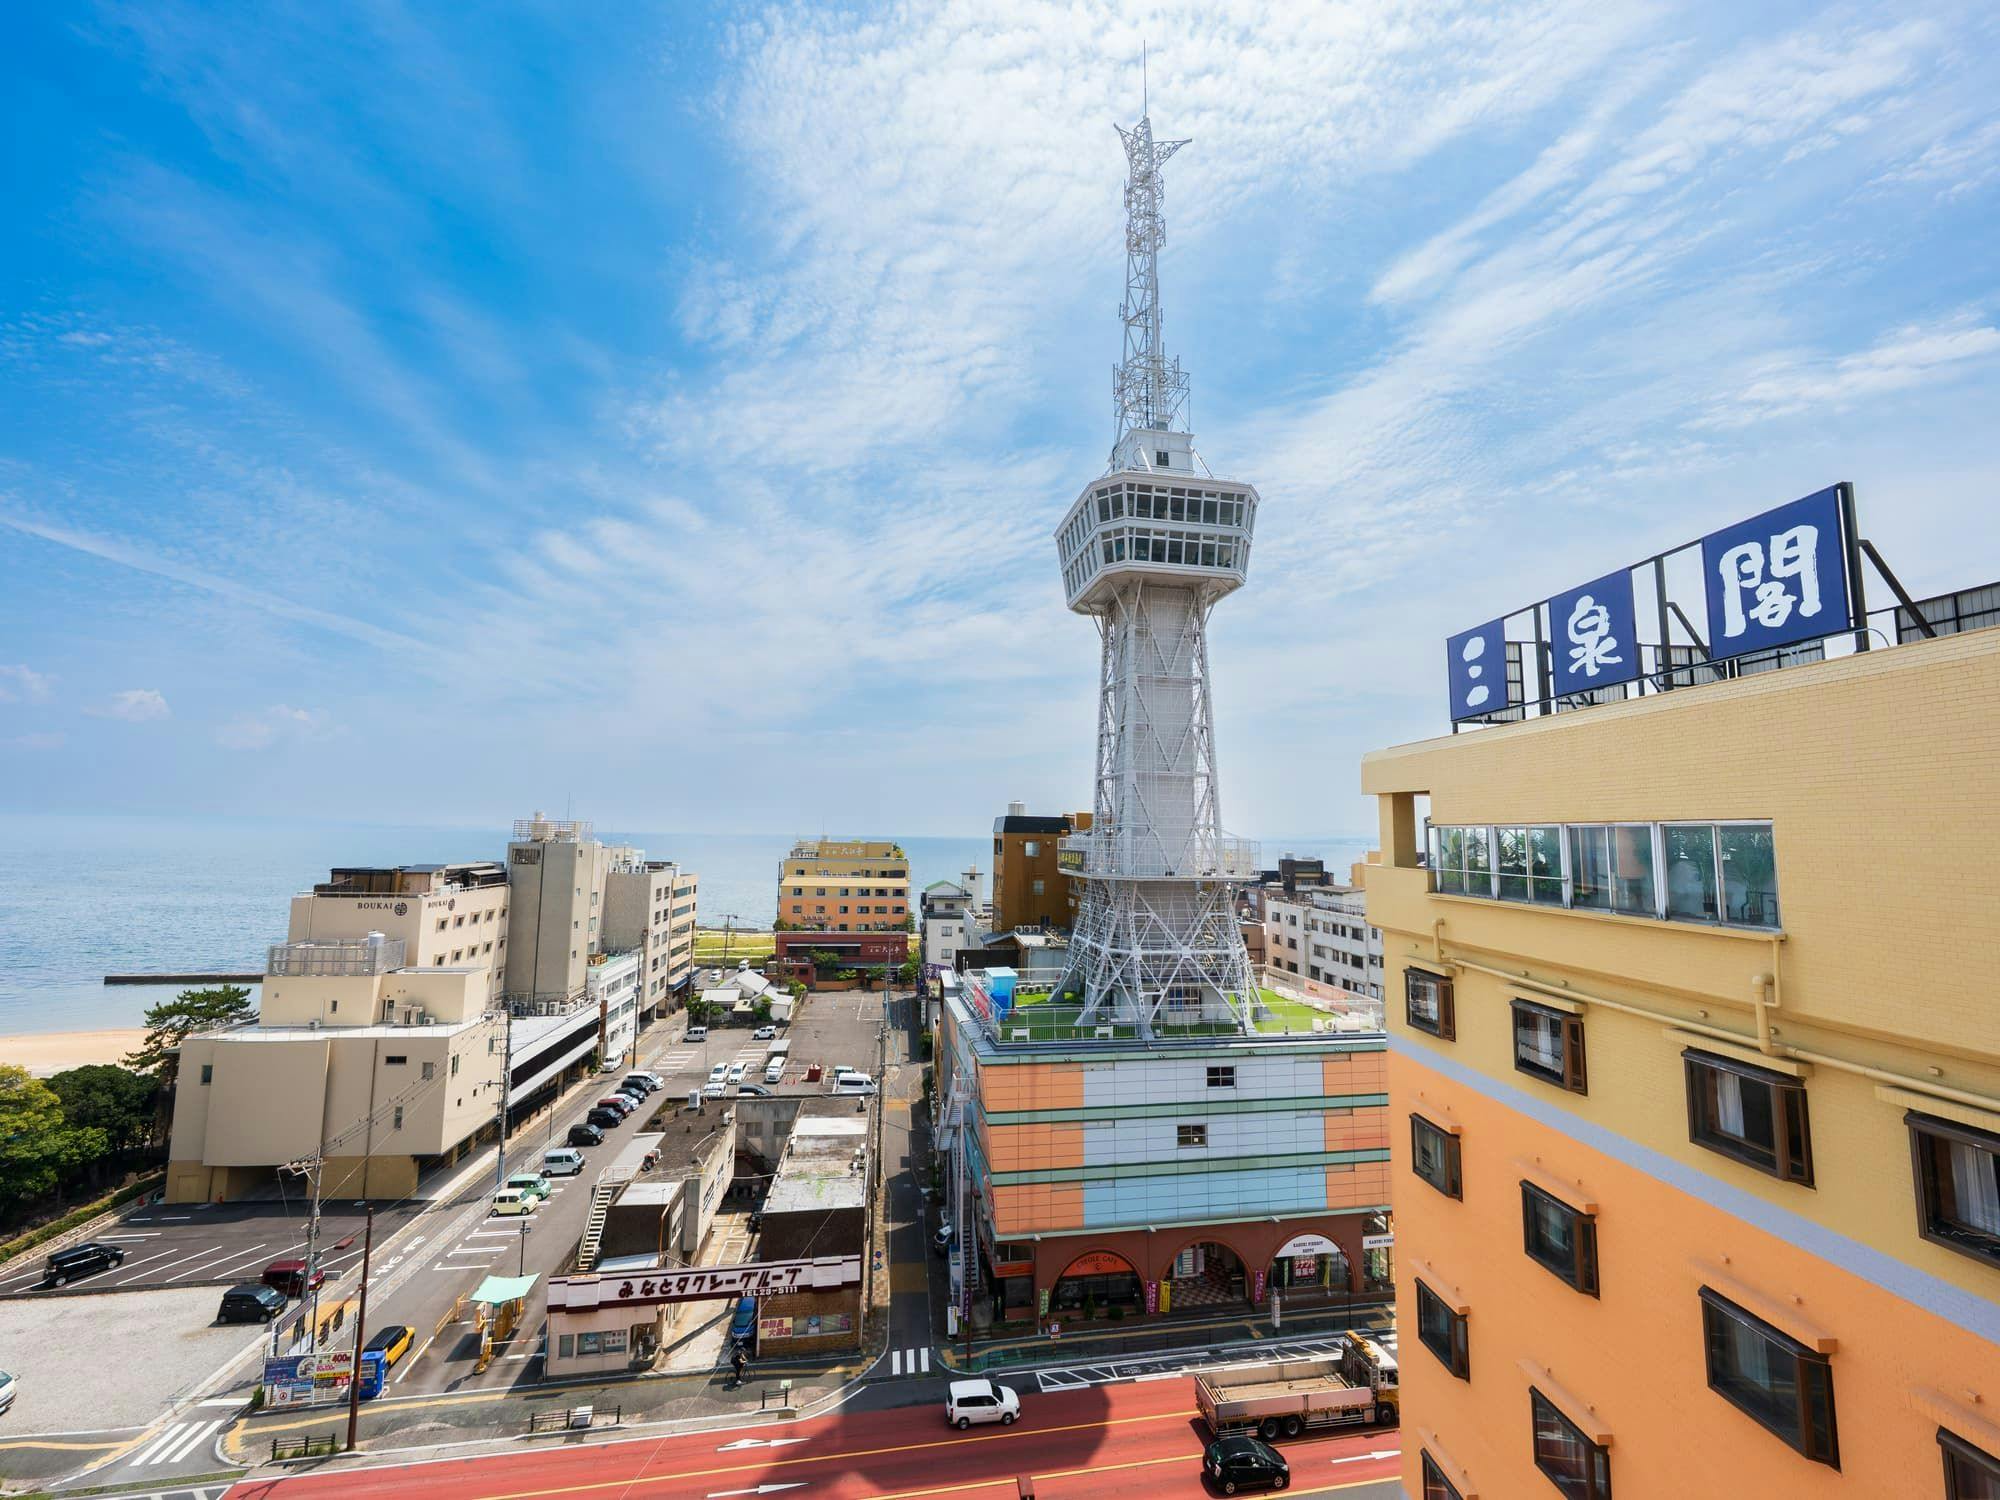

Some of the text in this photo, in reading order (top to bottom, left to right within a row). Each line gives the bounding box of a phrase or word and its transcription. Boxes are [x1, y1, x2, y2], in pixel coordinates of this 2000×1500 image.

[357, 902, 393, 910] BOUKAI
[618, 1268, 802, 1298] みなとタクシーグループ
